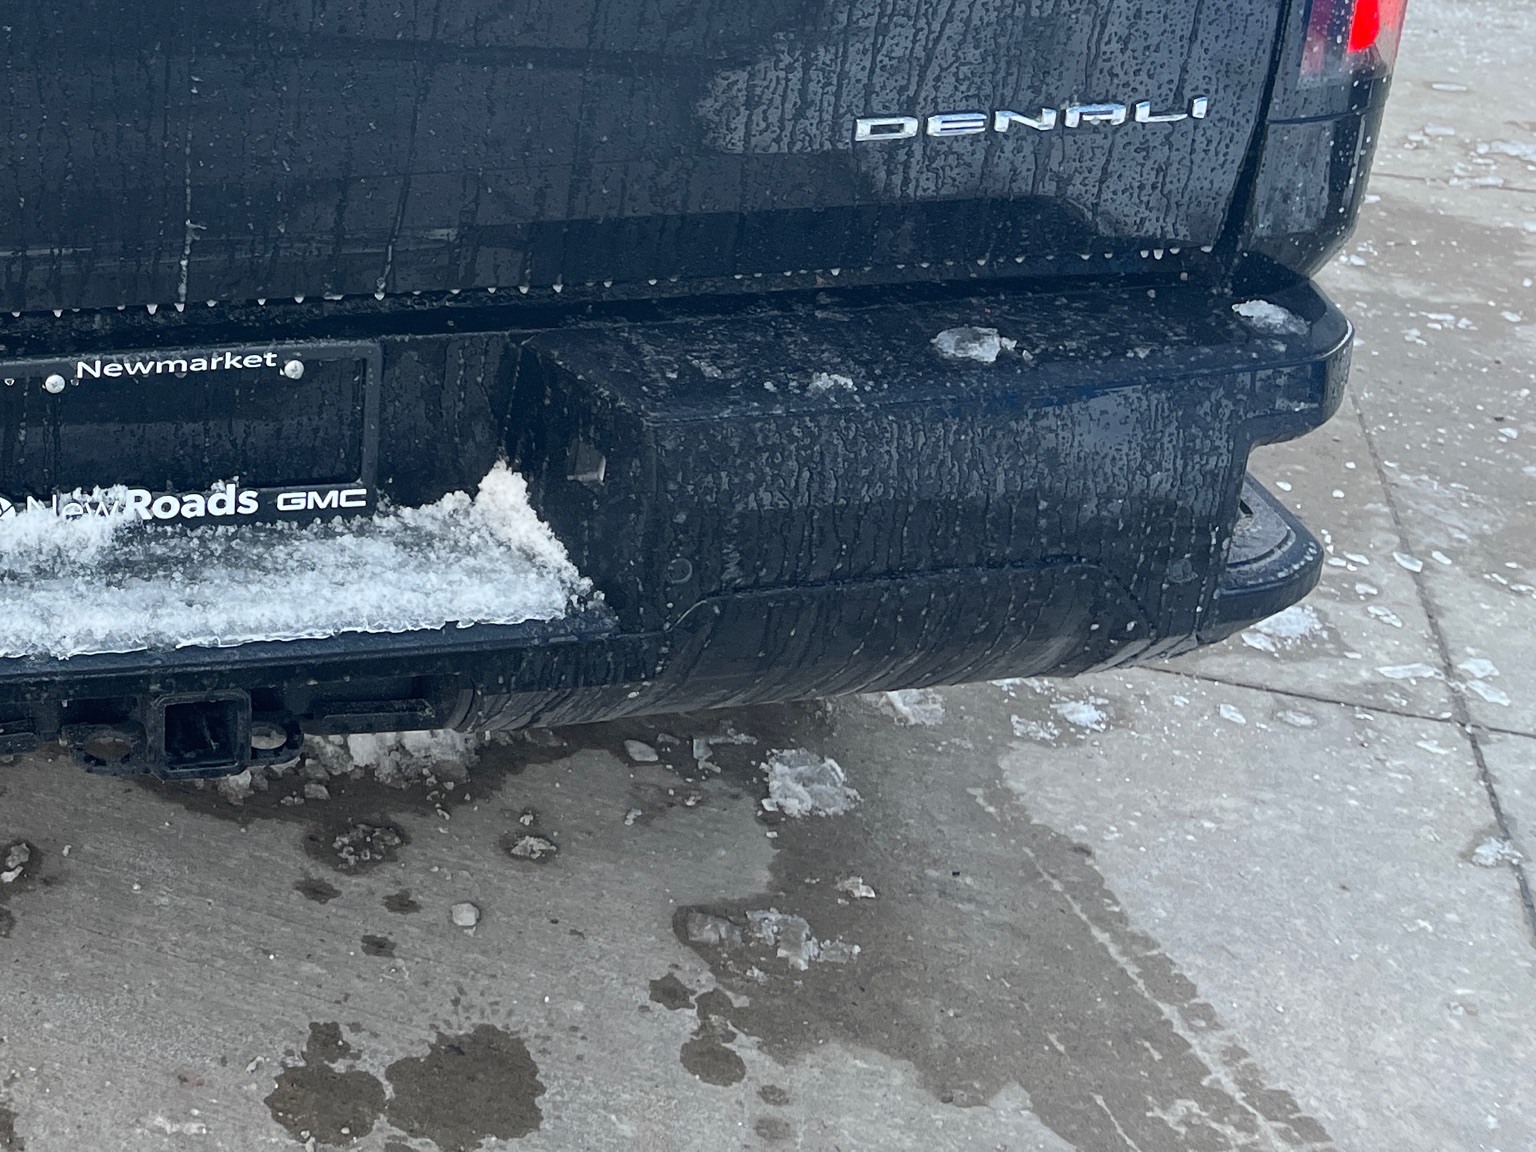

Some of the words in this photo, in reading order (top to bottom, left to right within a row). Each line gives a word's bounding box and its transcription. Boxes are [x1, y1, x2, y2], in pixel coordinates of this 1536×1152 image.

[855, 96, 1209, 141] DENALI
[76, 351, 277, 380] Newmarket
[276, 488, 367, 511] GMC
